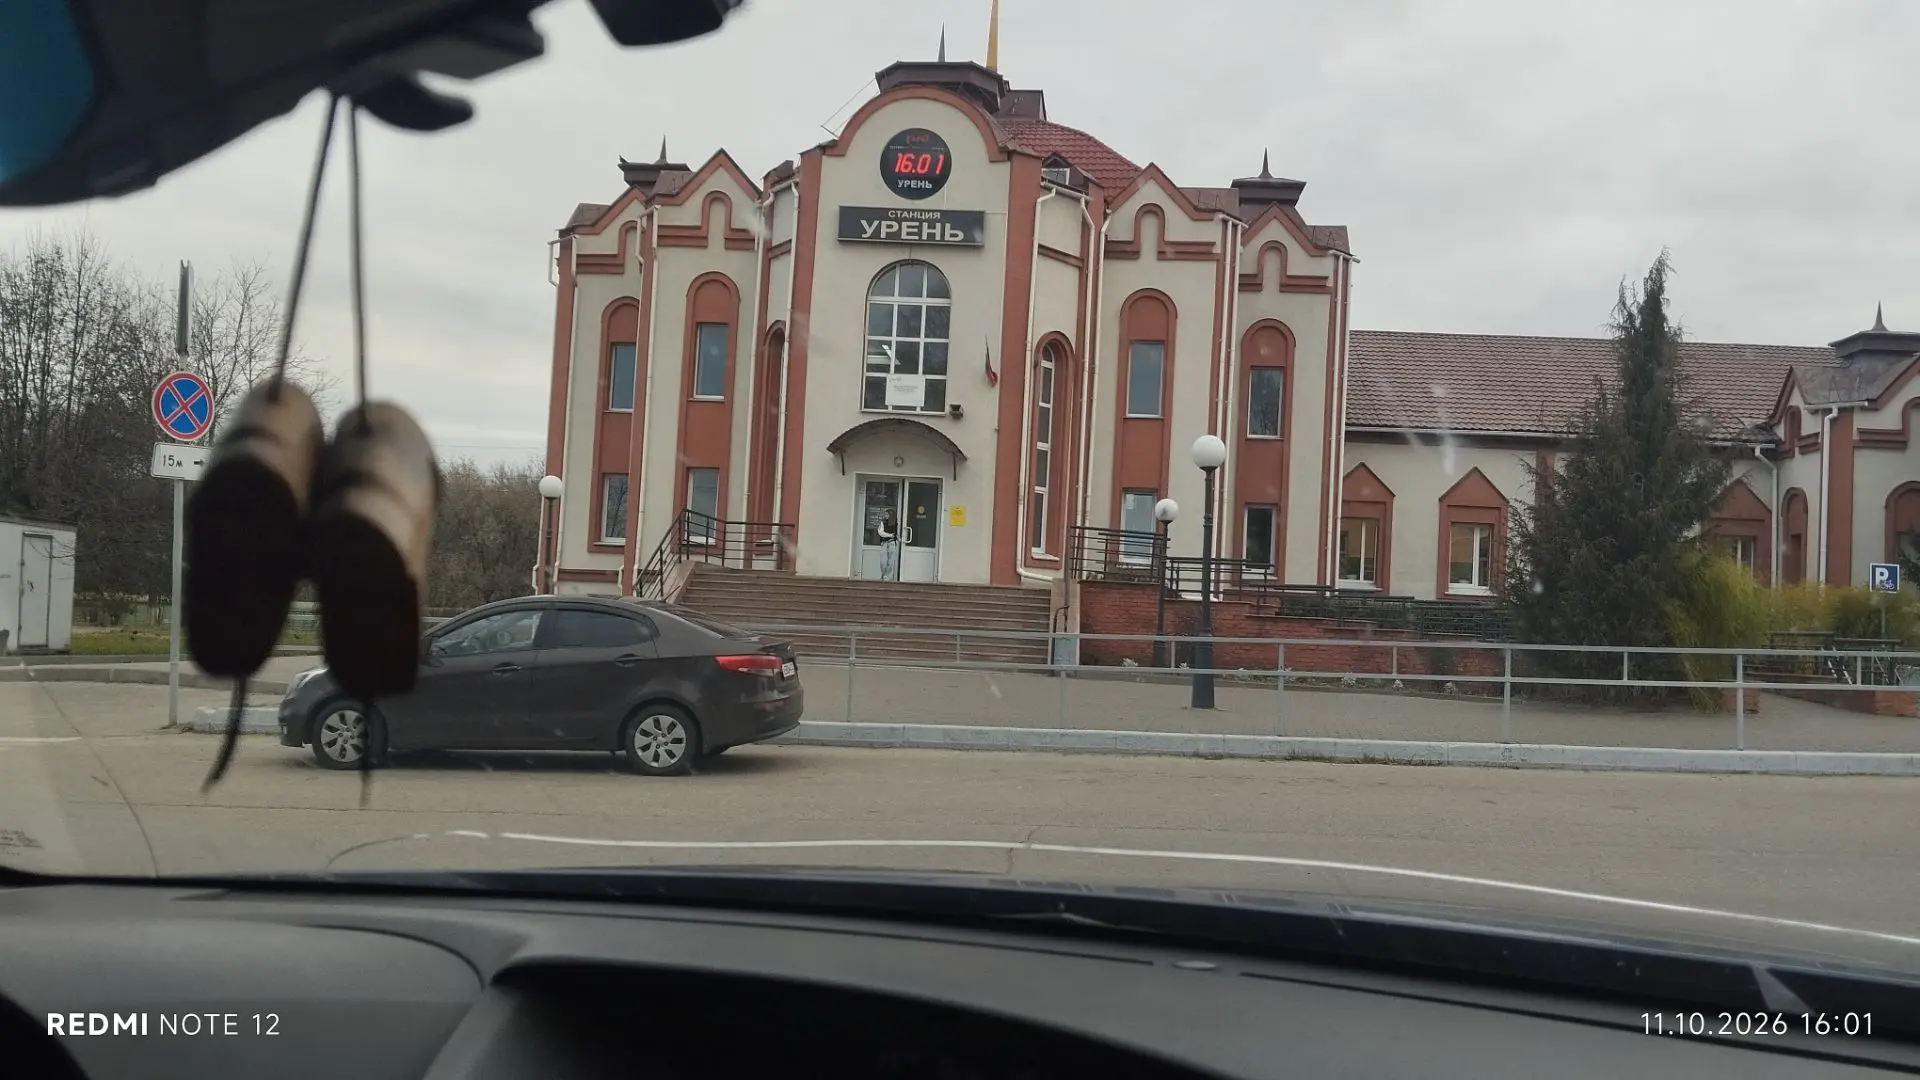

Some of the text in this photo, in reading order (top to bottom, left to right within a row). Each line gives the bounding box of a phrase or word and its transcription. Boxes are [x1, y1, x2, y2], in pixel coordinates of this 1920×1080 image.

[897, 179, 932, 189] УРЕНЬ
[888, 210, 941, 220] СТАНЦИЯ
[860, 219, 964, 242] УРЕНЬ
